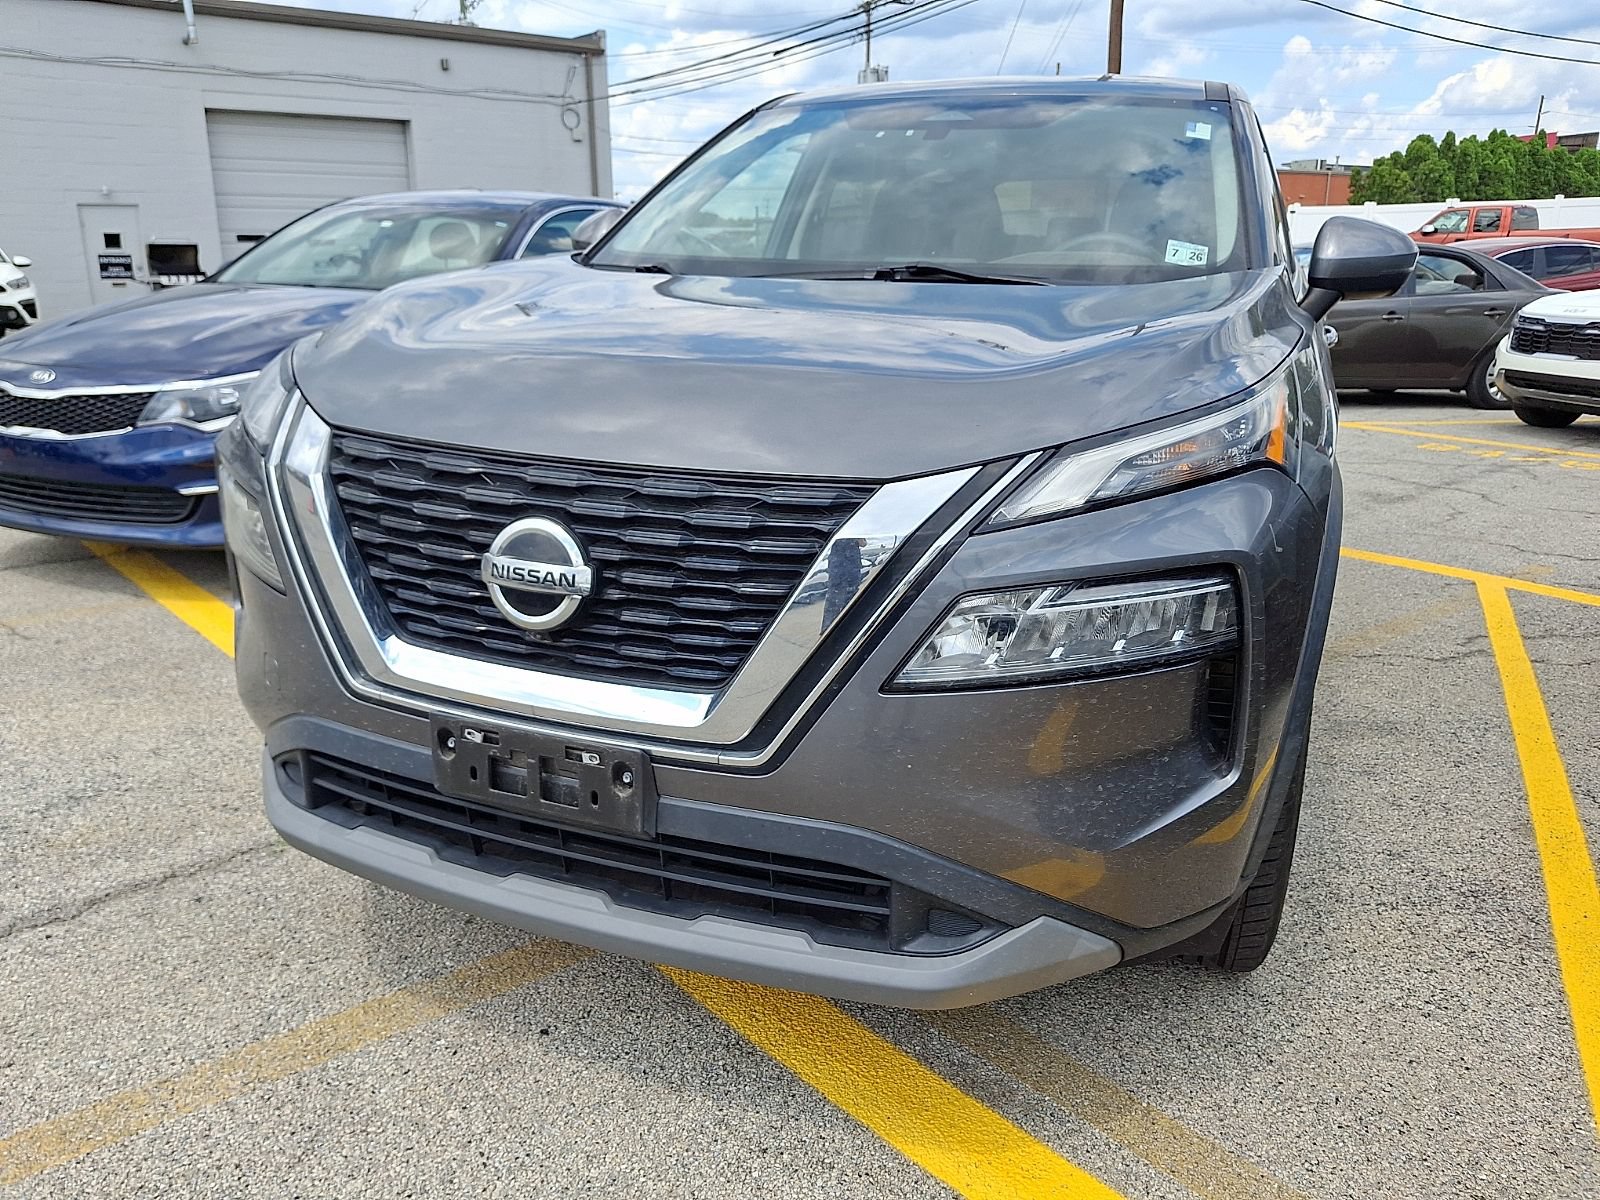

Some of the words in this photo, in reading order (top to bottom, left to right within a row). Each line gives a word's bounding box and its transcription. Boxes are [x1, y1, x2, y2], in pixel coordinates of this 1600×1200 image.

[1171, 248, 1179, 257] 7
[1189, 251, 1203, 262] 26
[491, 562, 576, 588] NISSAN
